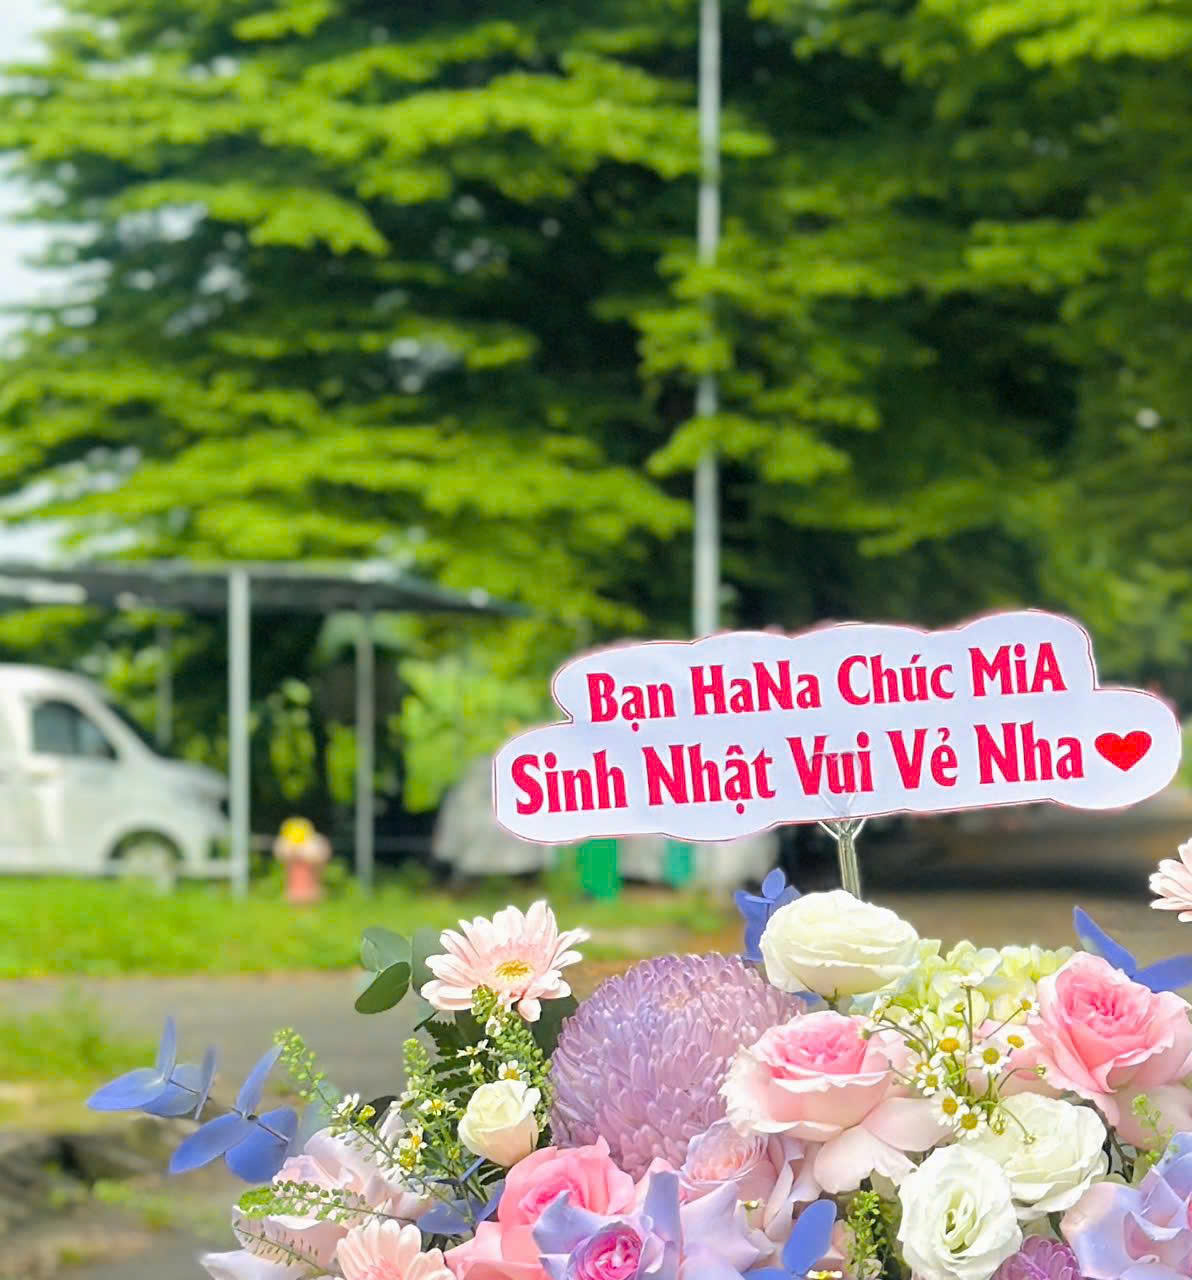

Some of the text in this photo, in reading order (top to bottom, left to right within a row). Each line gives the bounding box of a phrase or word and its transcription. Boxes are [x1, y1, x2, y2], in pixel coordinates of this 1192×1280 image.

[586, 642, 1067, 732] Bạn HaNa Chúc MiA
[511, 719, 1085, 816] Sinh Nhật Vui Vẻ Nha
